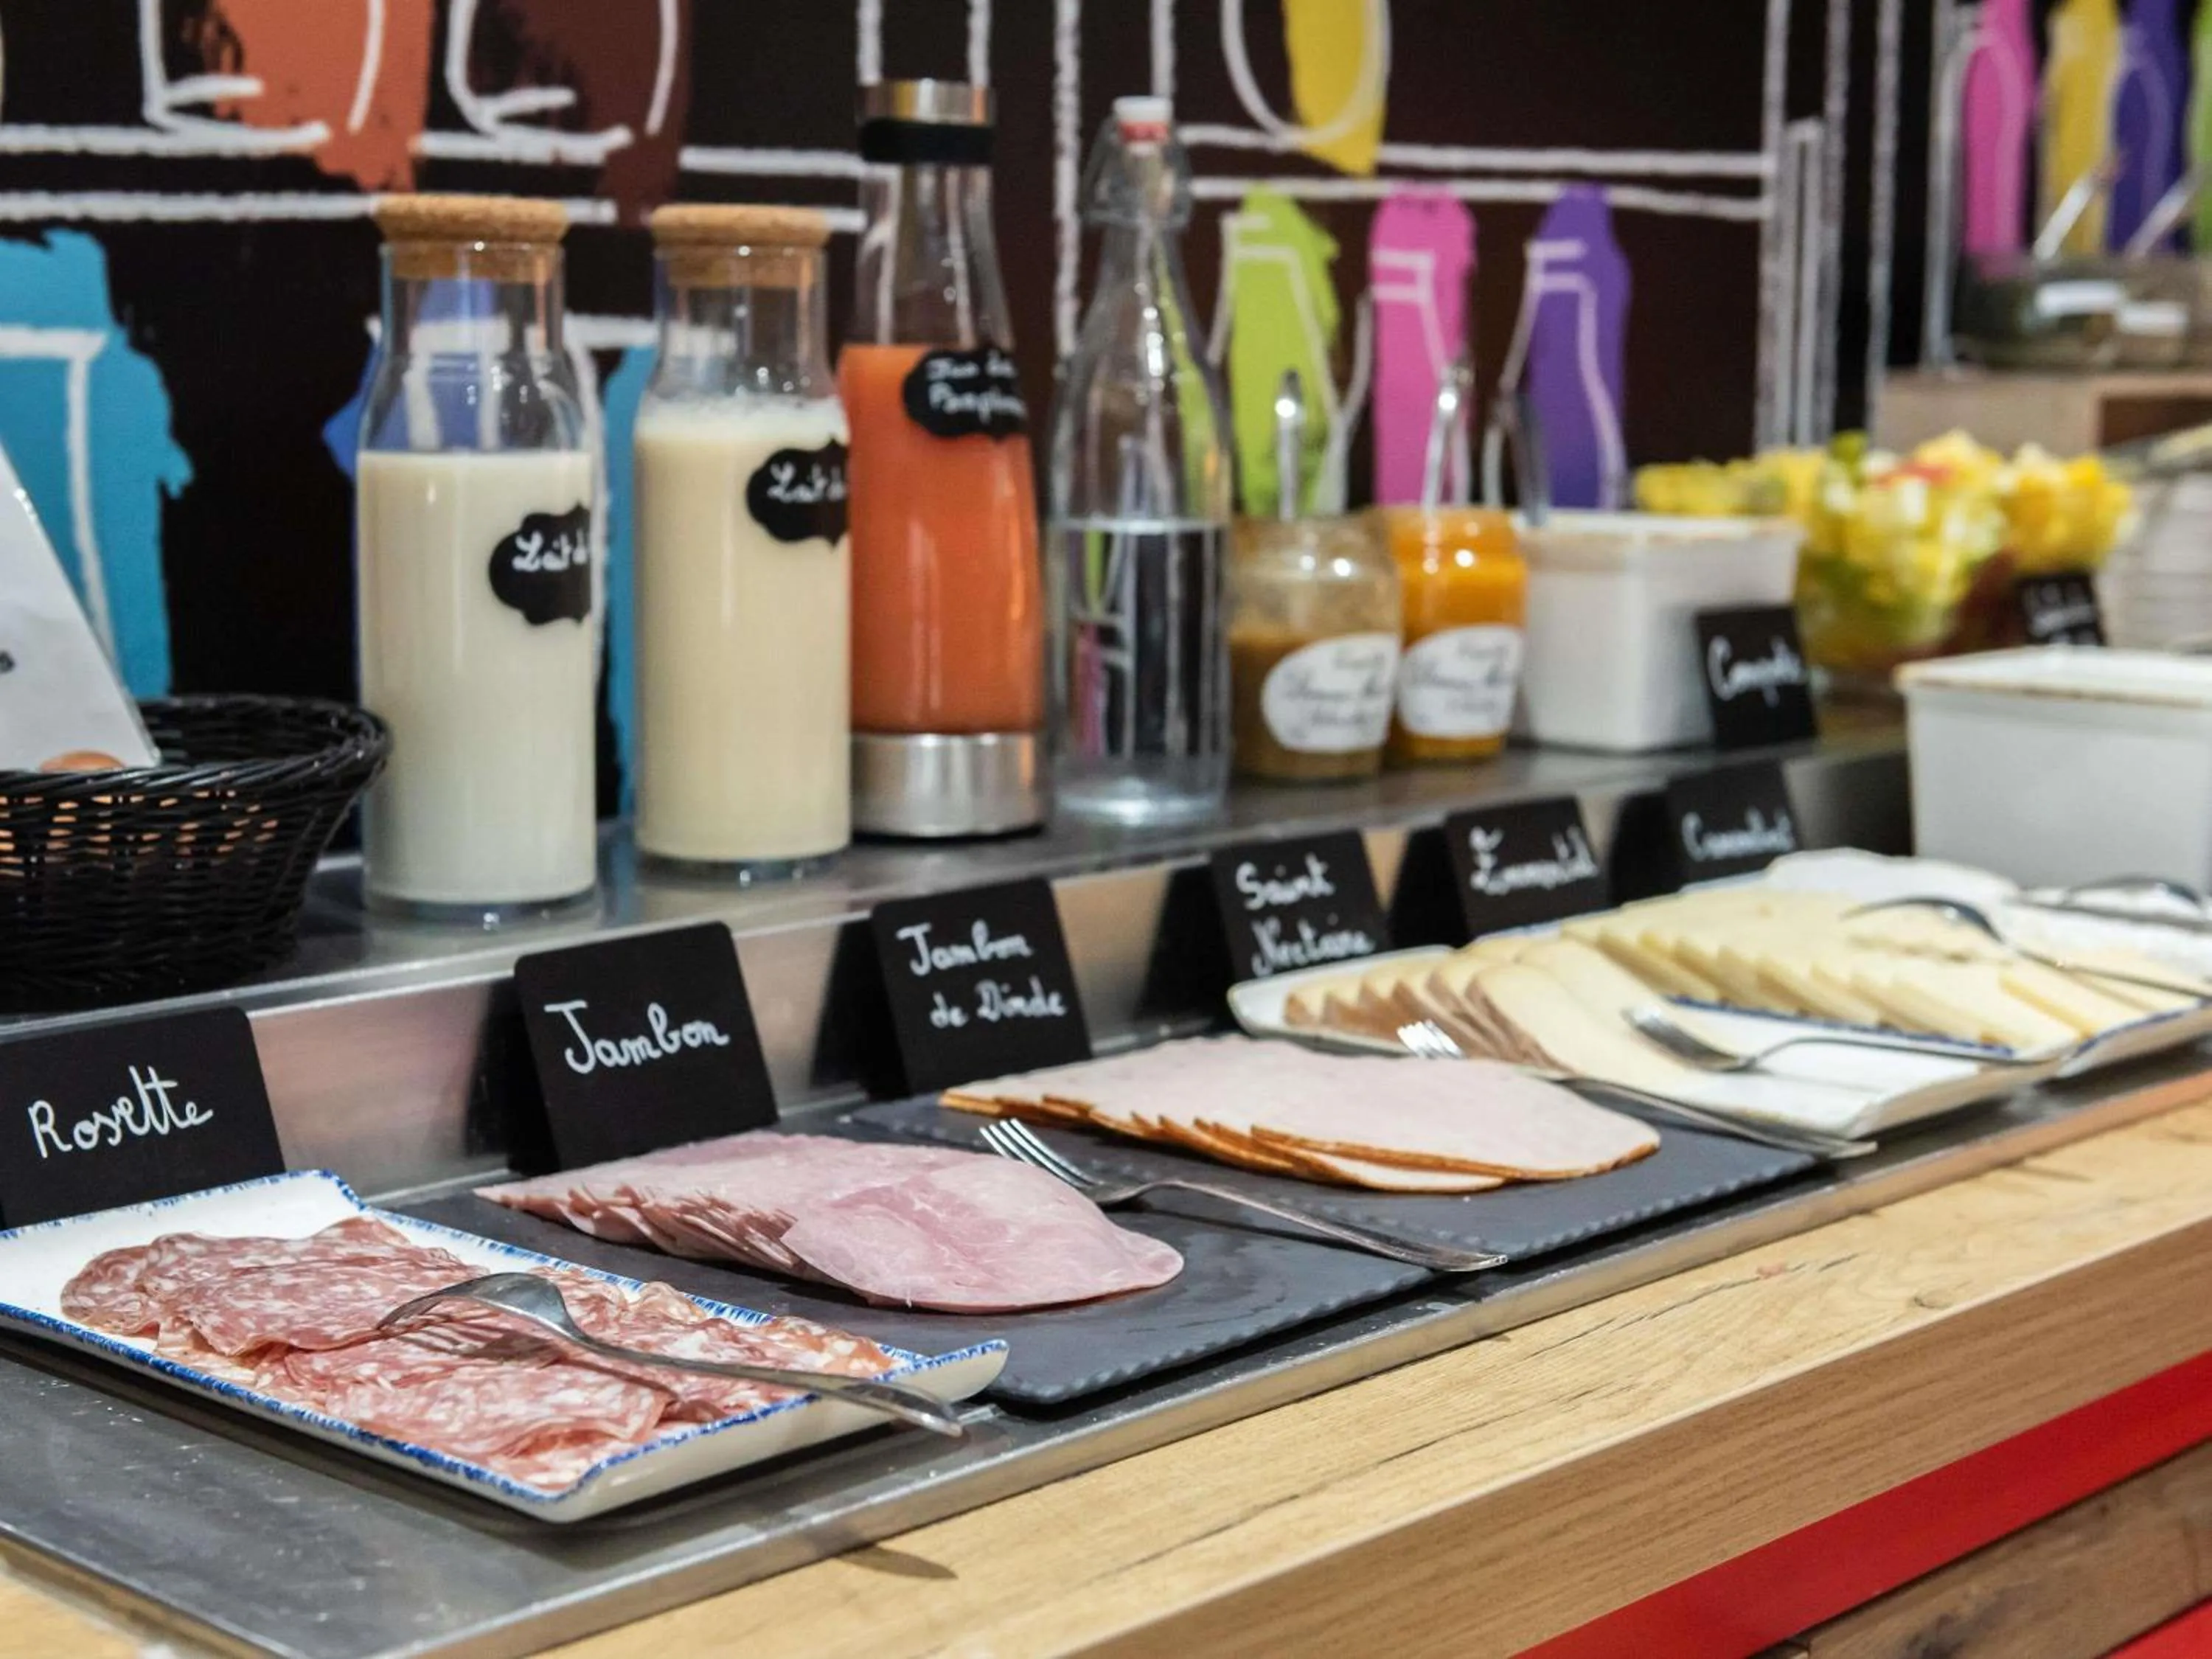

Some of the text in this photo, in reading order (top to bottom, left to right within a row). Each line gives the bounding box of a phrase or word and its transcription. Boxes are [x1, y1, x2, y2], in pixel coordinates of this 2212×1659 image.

[511, 529, 571, 573] Lait
[1235, 851, 1335, 911] Saint
[895, 918, 1034, 976] Jambon
[930, 975, 1067, 1029] de Dinde
[543, 999, 731, 1074] Jambon
[27, 1065, 214, 1158] Rosette
